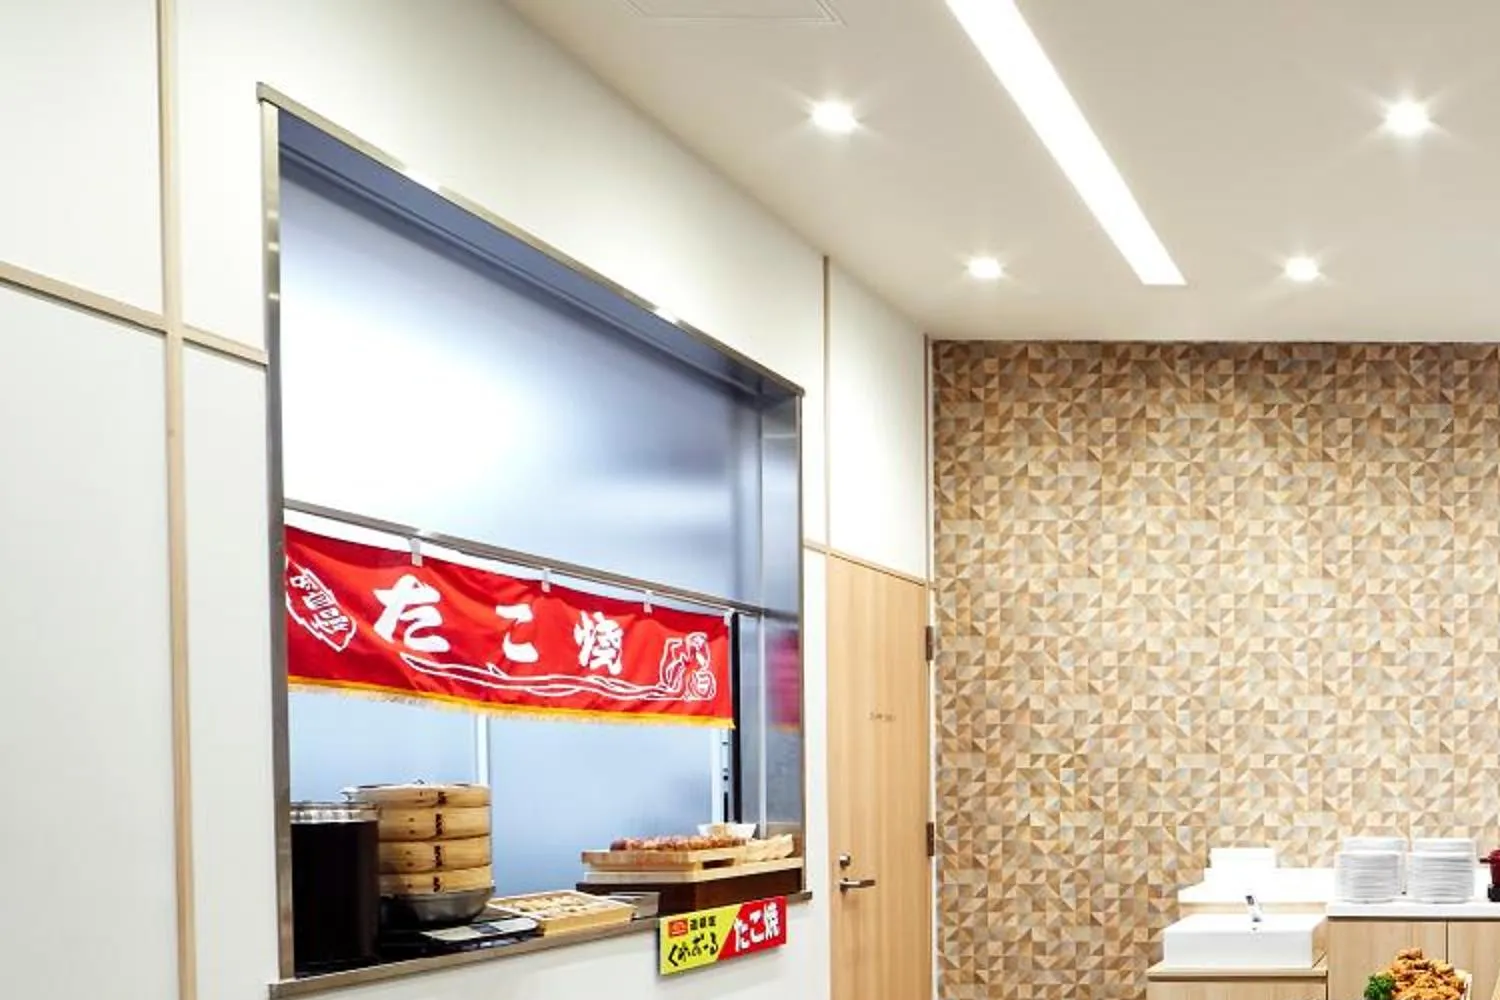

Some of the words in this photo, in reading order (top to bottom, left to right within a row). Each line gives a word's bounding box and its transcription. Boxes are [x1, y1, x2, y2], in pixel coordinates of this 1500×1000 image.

[373, 574, 622, 676] たこ焼
[734, 902, 780, 952] たこ焼
